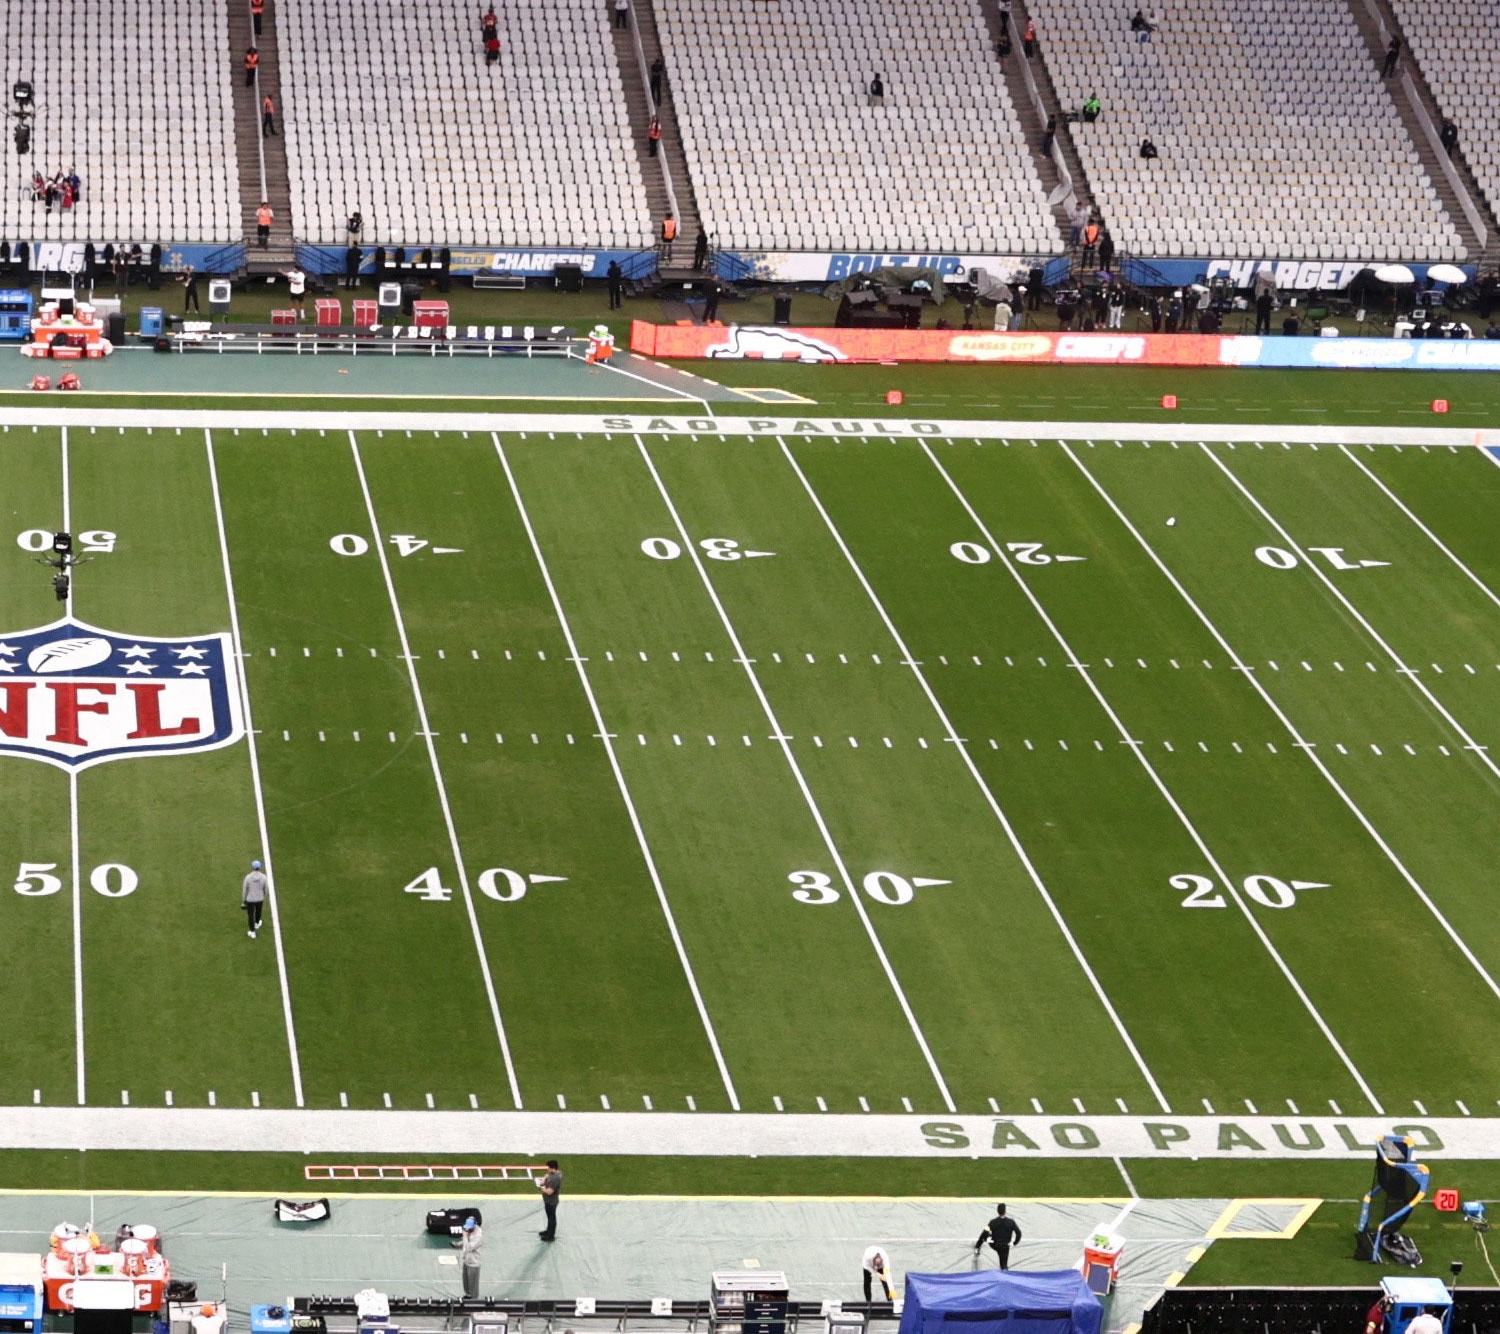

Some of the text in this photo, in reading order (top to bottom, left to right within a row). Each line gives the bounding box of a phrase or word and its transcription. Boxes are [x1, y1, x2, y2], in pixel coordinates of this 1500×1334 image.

[492, 253, 596, 272] CHARGERS
[1206, 261, 1380, 291] CHARGER
[962, 342, 1036, 351] KANSAS CITY
[748, 420, 943, 435] PAULO
[17, 529, 118, 554] 50
[330, 534, 431, 557] 40
[640, 536, 743, 562] 30
[949, 541, 1054, 568] 20
[1254, 545, 1368, 571] 10
[13, 861, 140, 899] 50
[404, 866, 528, 903] 40
[788, 870, 915, 906] 30
[1169, 874, 1297, 909] 20
[920, 1119, 1446, 1153] SÃO PAULO
[1440, 1193, 1456, 1208] 20
